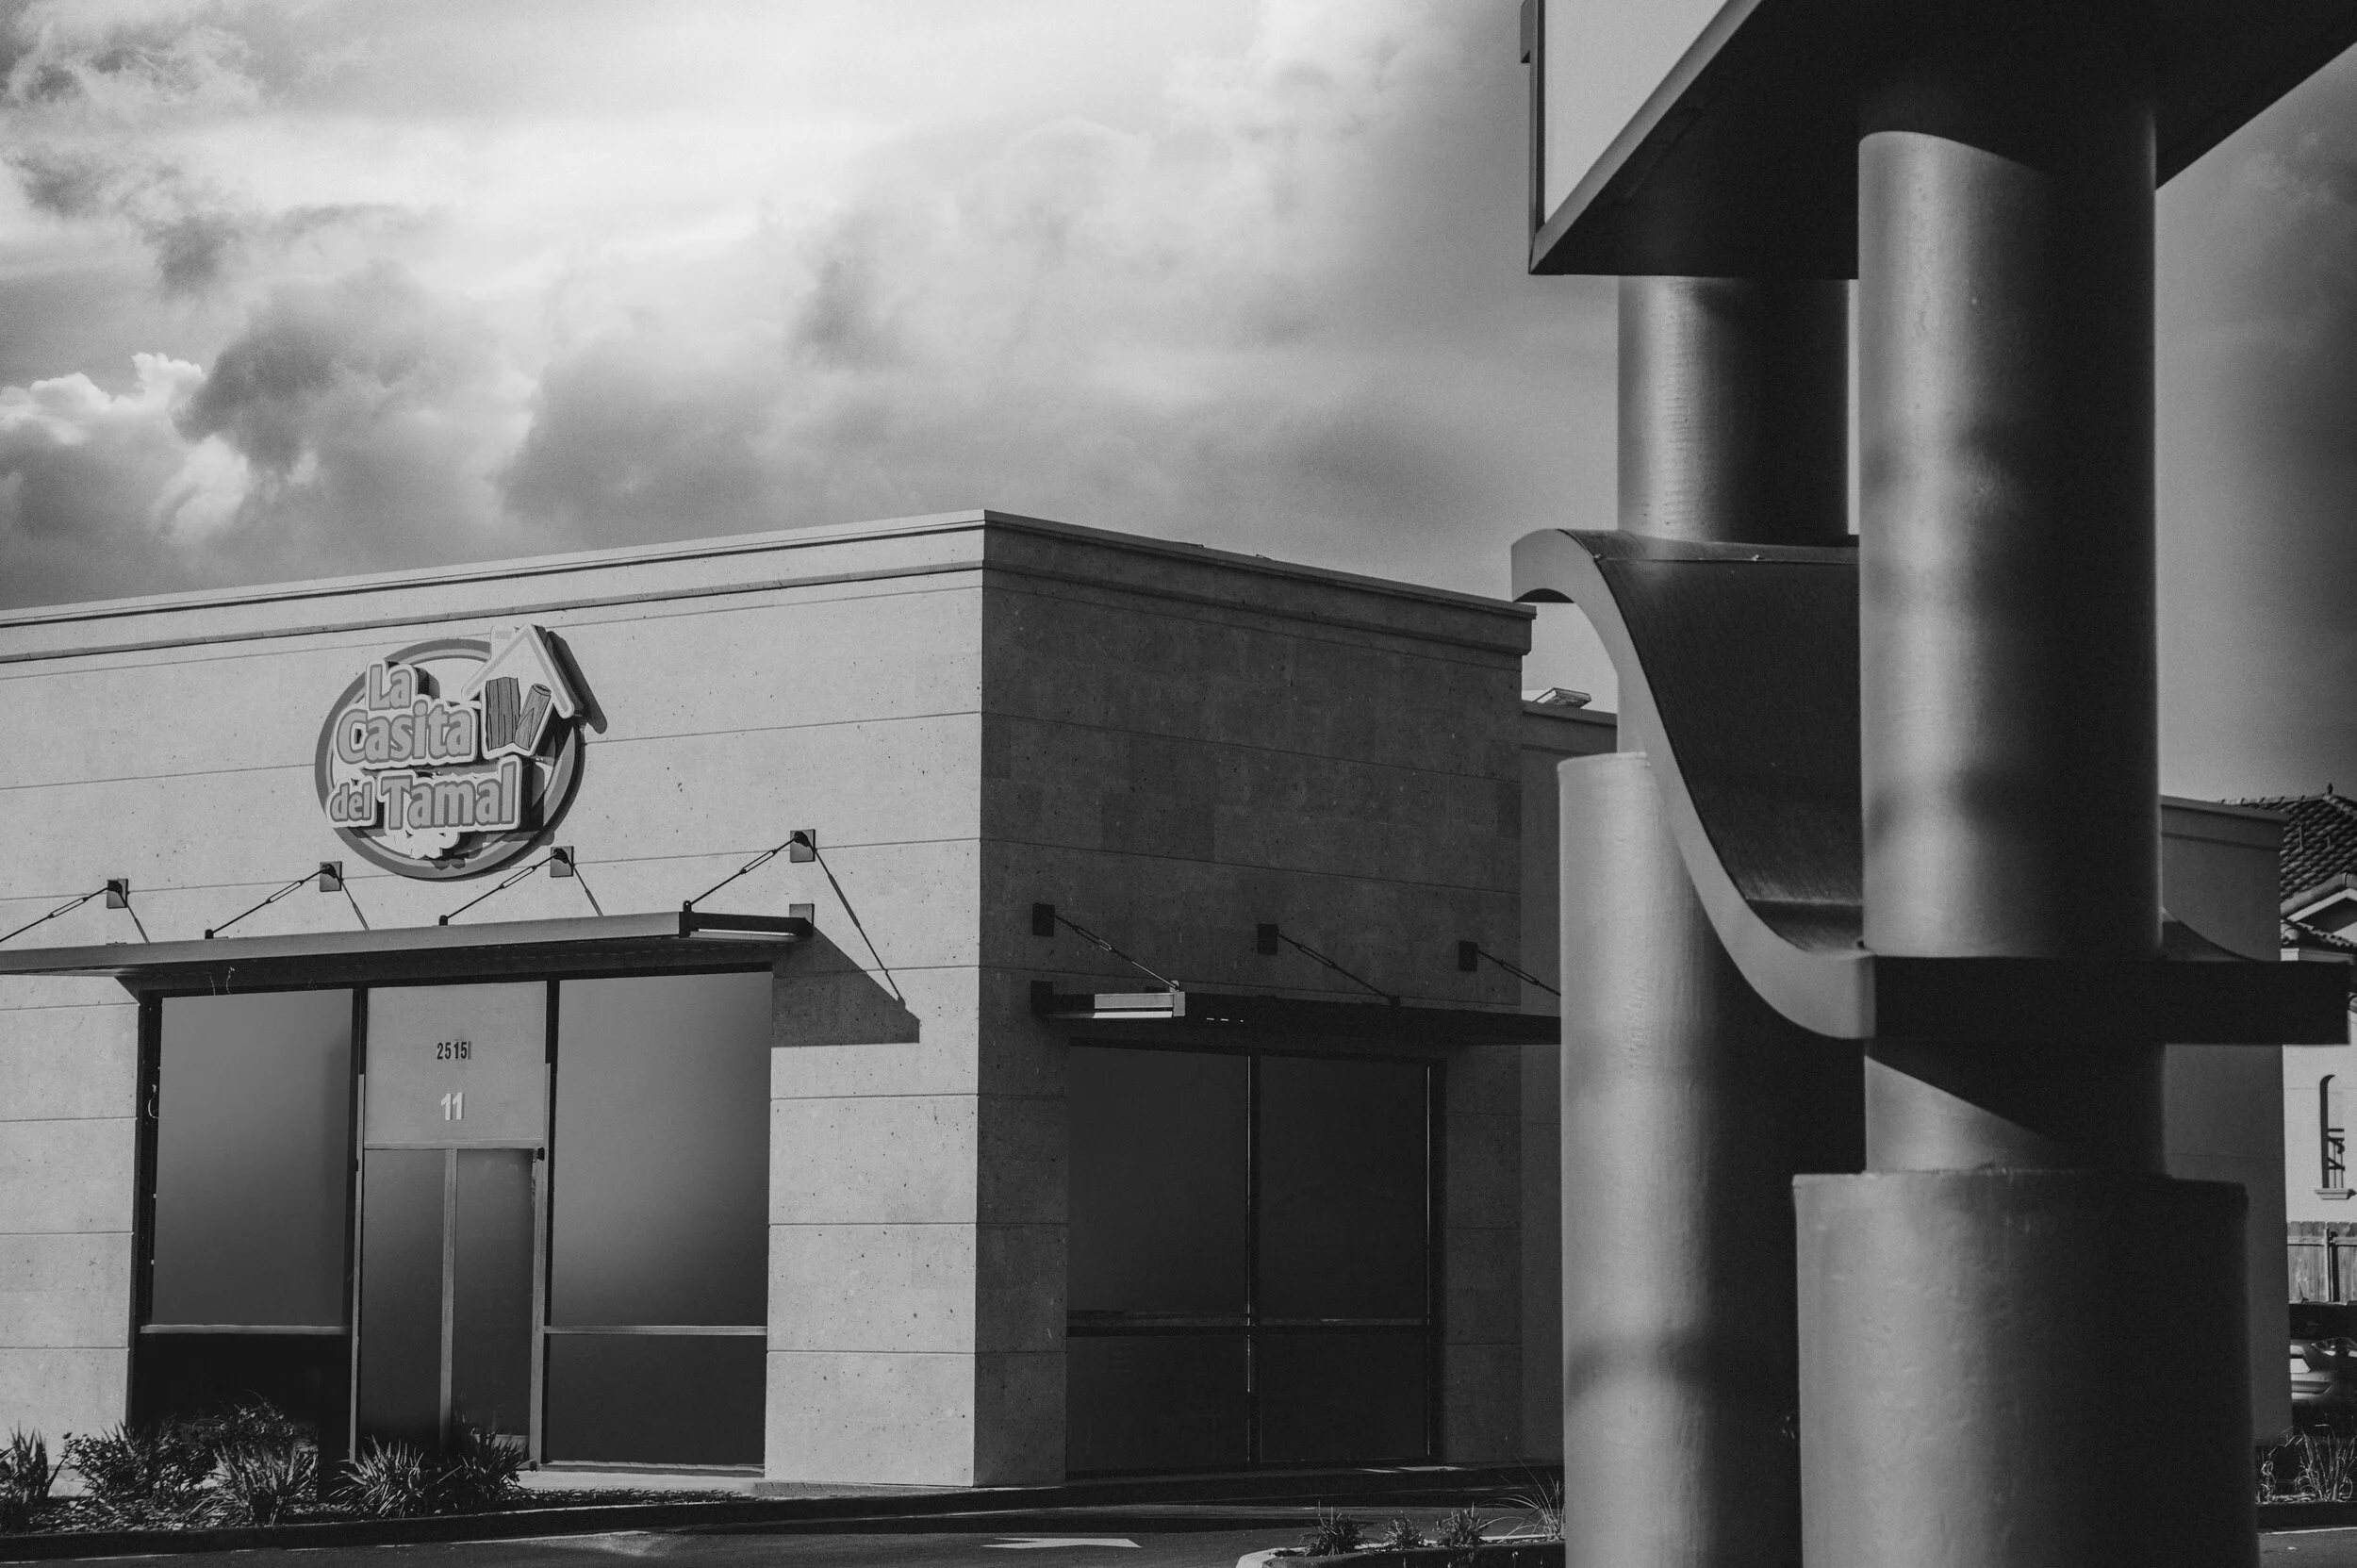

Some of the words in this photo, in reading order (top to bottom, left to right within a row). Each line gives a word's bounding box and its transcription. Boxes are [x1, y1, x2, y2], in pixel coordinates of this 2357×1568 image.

[368, 663, 412, 711] La
[336, 699, 473, 765] Casita
[329, 780, 373, 823] del
[380, 760, 518, 831] Tamal
[437, 1041, 468, 1060] 2515
[440, 1092, 463, 1121] 11
